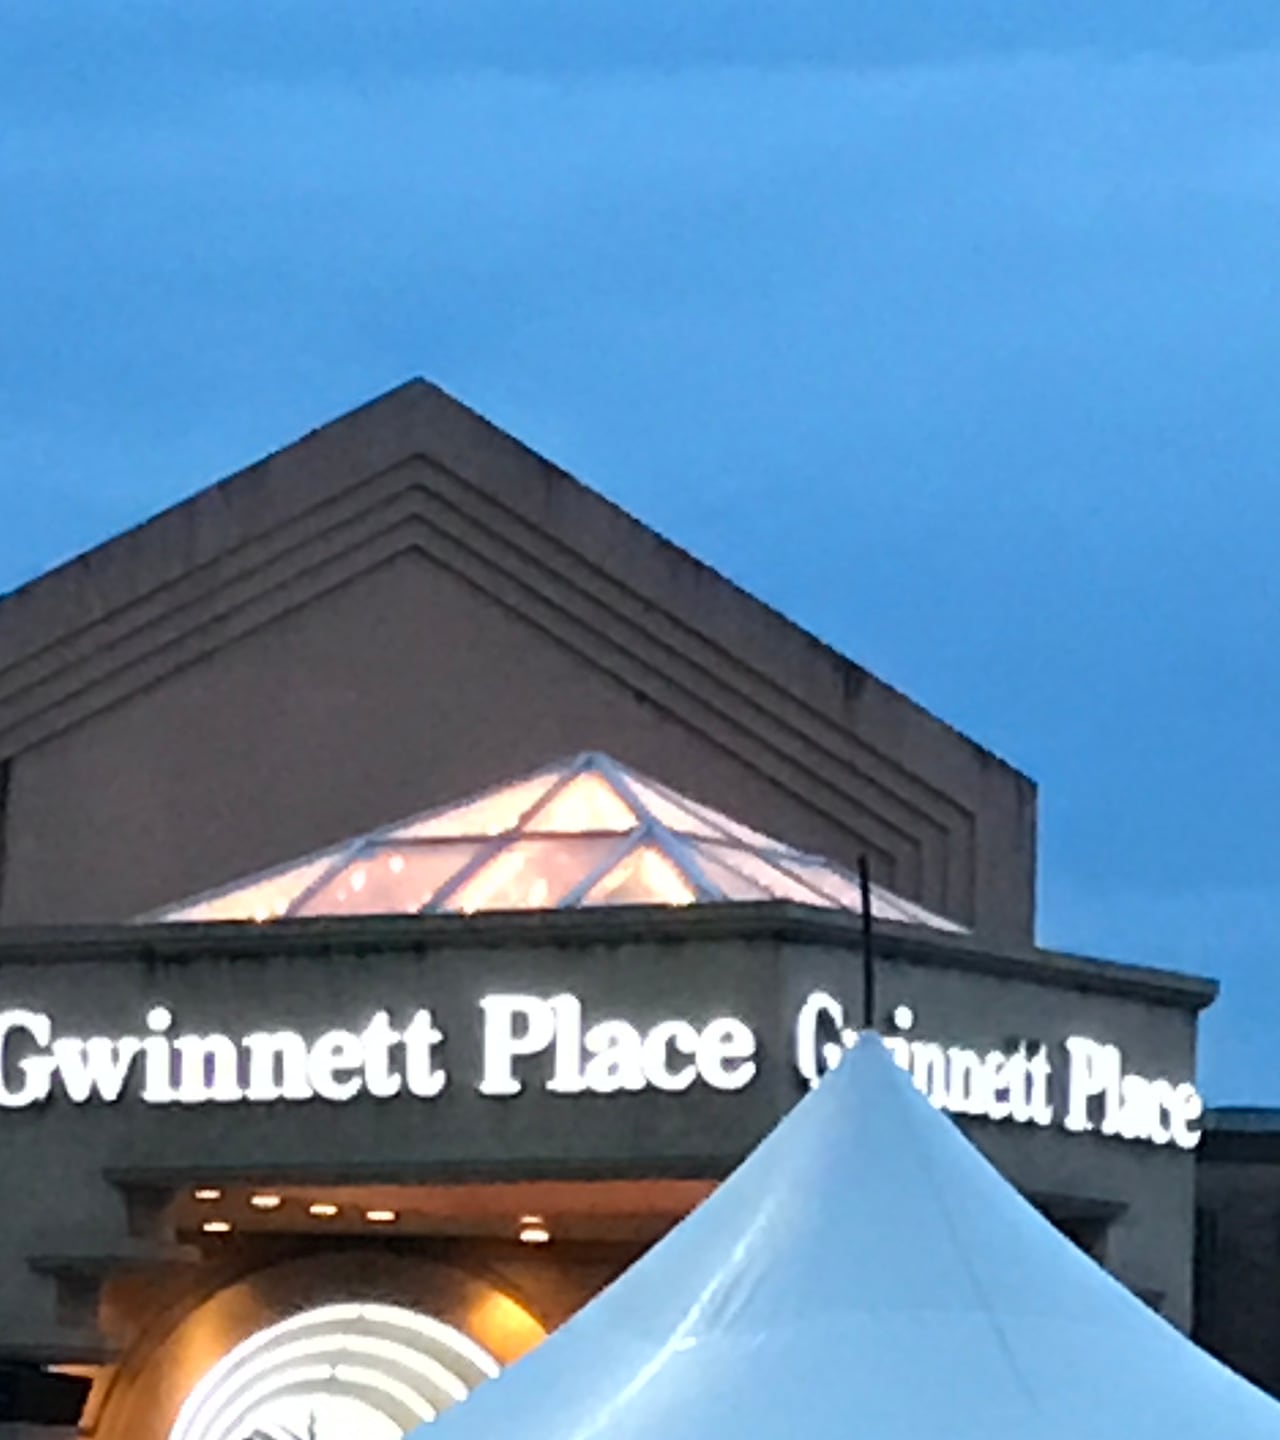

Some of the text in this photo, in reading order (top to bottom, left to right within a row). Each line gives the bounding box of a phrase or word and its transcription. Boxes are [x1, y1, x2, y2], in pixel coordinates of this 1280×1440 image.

[478, 991, 756, 1095] Place
[796, 991, 1203, 1149] Ginnett Place
